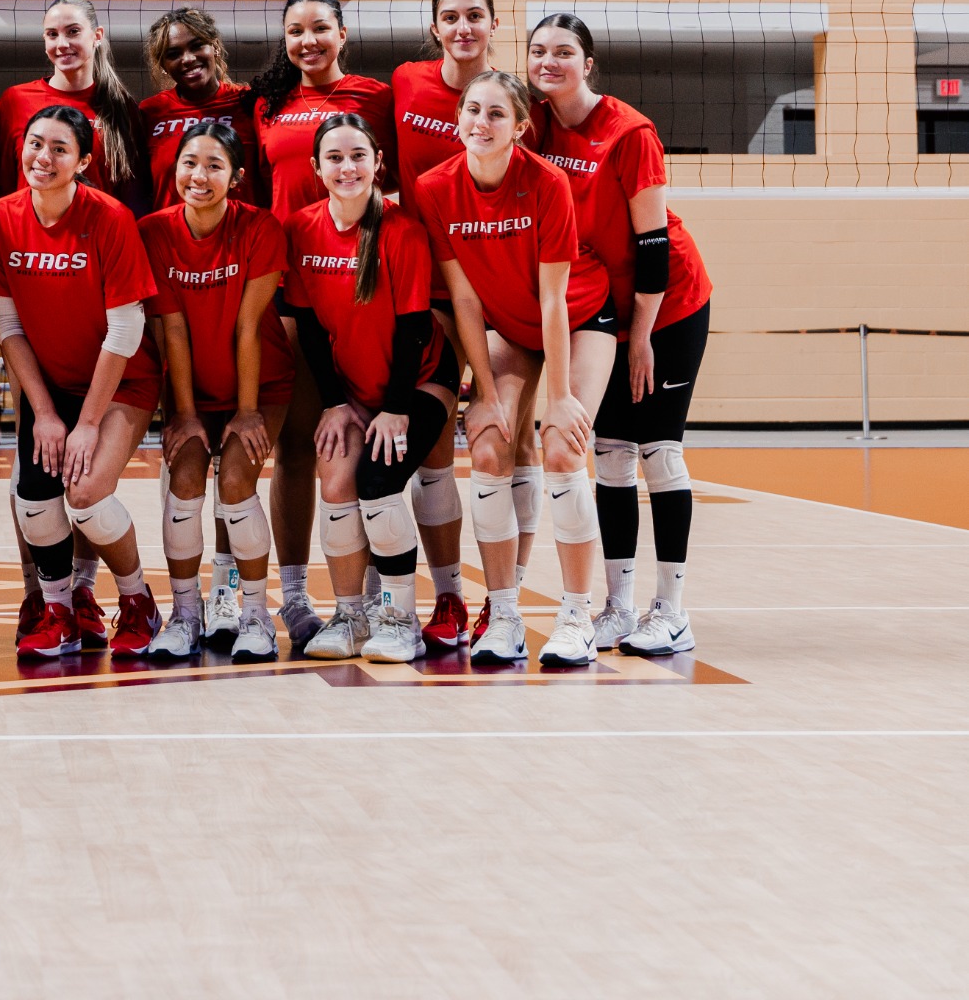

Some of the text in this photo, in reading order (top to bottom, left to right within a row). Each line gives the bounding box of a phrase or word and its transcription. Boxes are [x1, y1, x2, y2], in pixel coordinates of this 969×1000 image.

[272, 111, 344, 125] FAIRFIE
[402, 111, 459, 136] FAIRFI
[8, 251, 88, 270] STAGS
[301, 255, 358, 269] FAIRFIE
